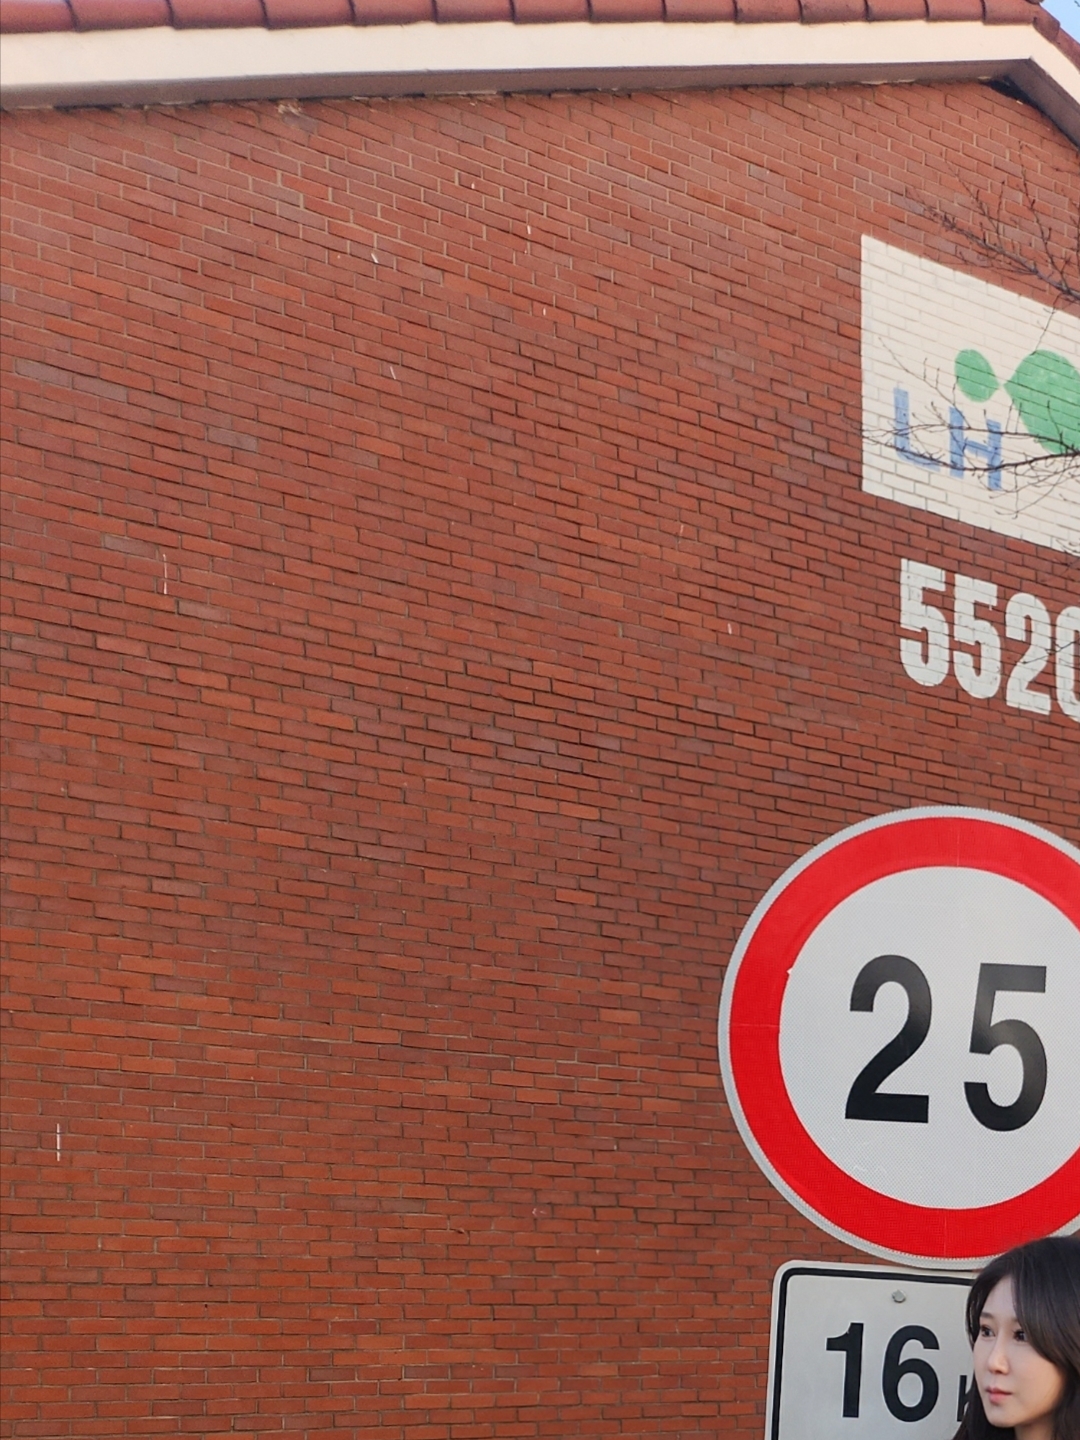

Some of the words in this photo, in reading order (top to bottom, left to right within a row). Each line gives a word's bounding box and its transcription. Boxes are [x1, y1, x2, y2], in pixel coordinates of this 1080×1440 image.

[893, 387, 1002, 490] LH
[845, 954, 1048, 1132] 25
[826, 1321, 940, 1423] 16
